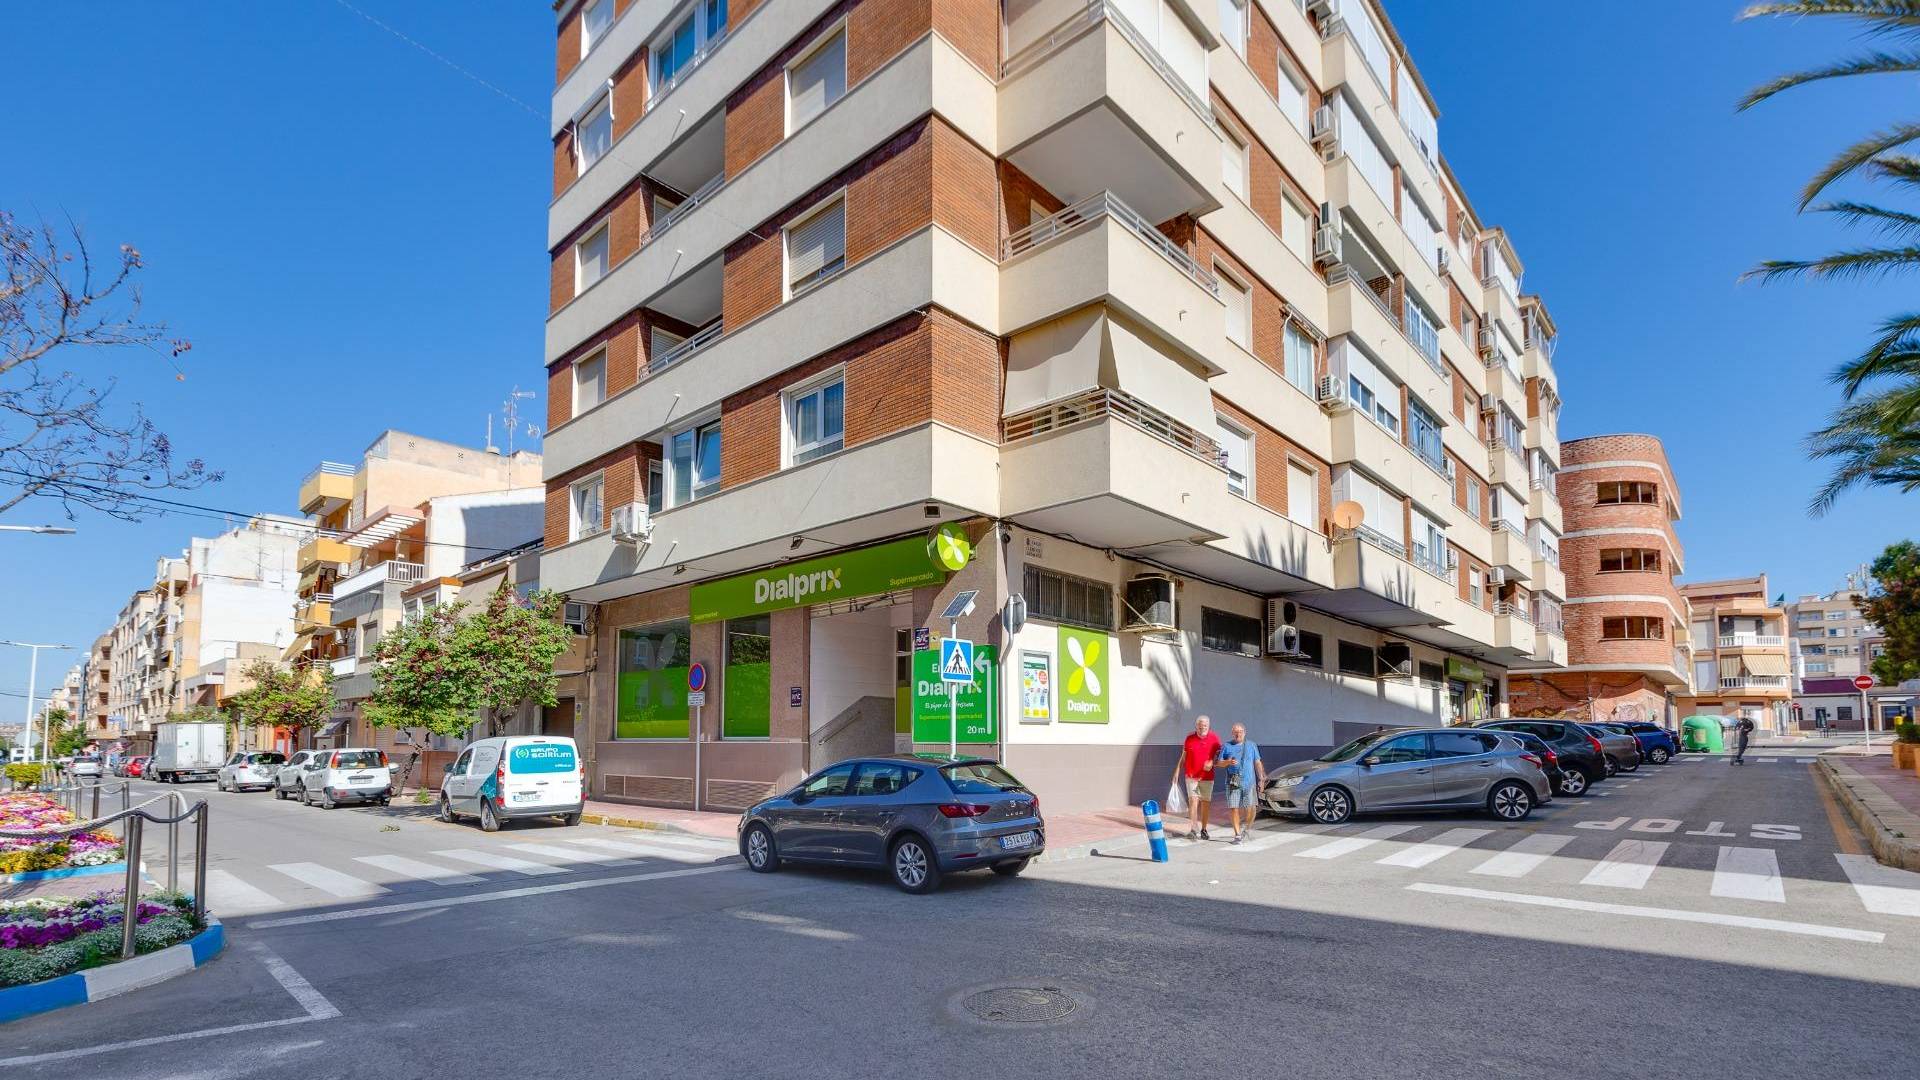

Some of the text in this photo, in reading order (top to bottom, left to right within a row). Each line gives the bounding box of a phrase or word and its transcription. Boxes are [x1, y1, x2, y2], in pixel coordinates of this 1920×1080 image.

[755, 567, 841, 604] Dialprix
[889, 572, 935, 586] Supermercado
[1067, 699, 1101, 714] Dialprix
[967, 725, 977, 734] 20
[1573, 816, 1802, 840] STOP
